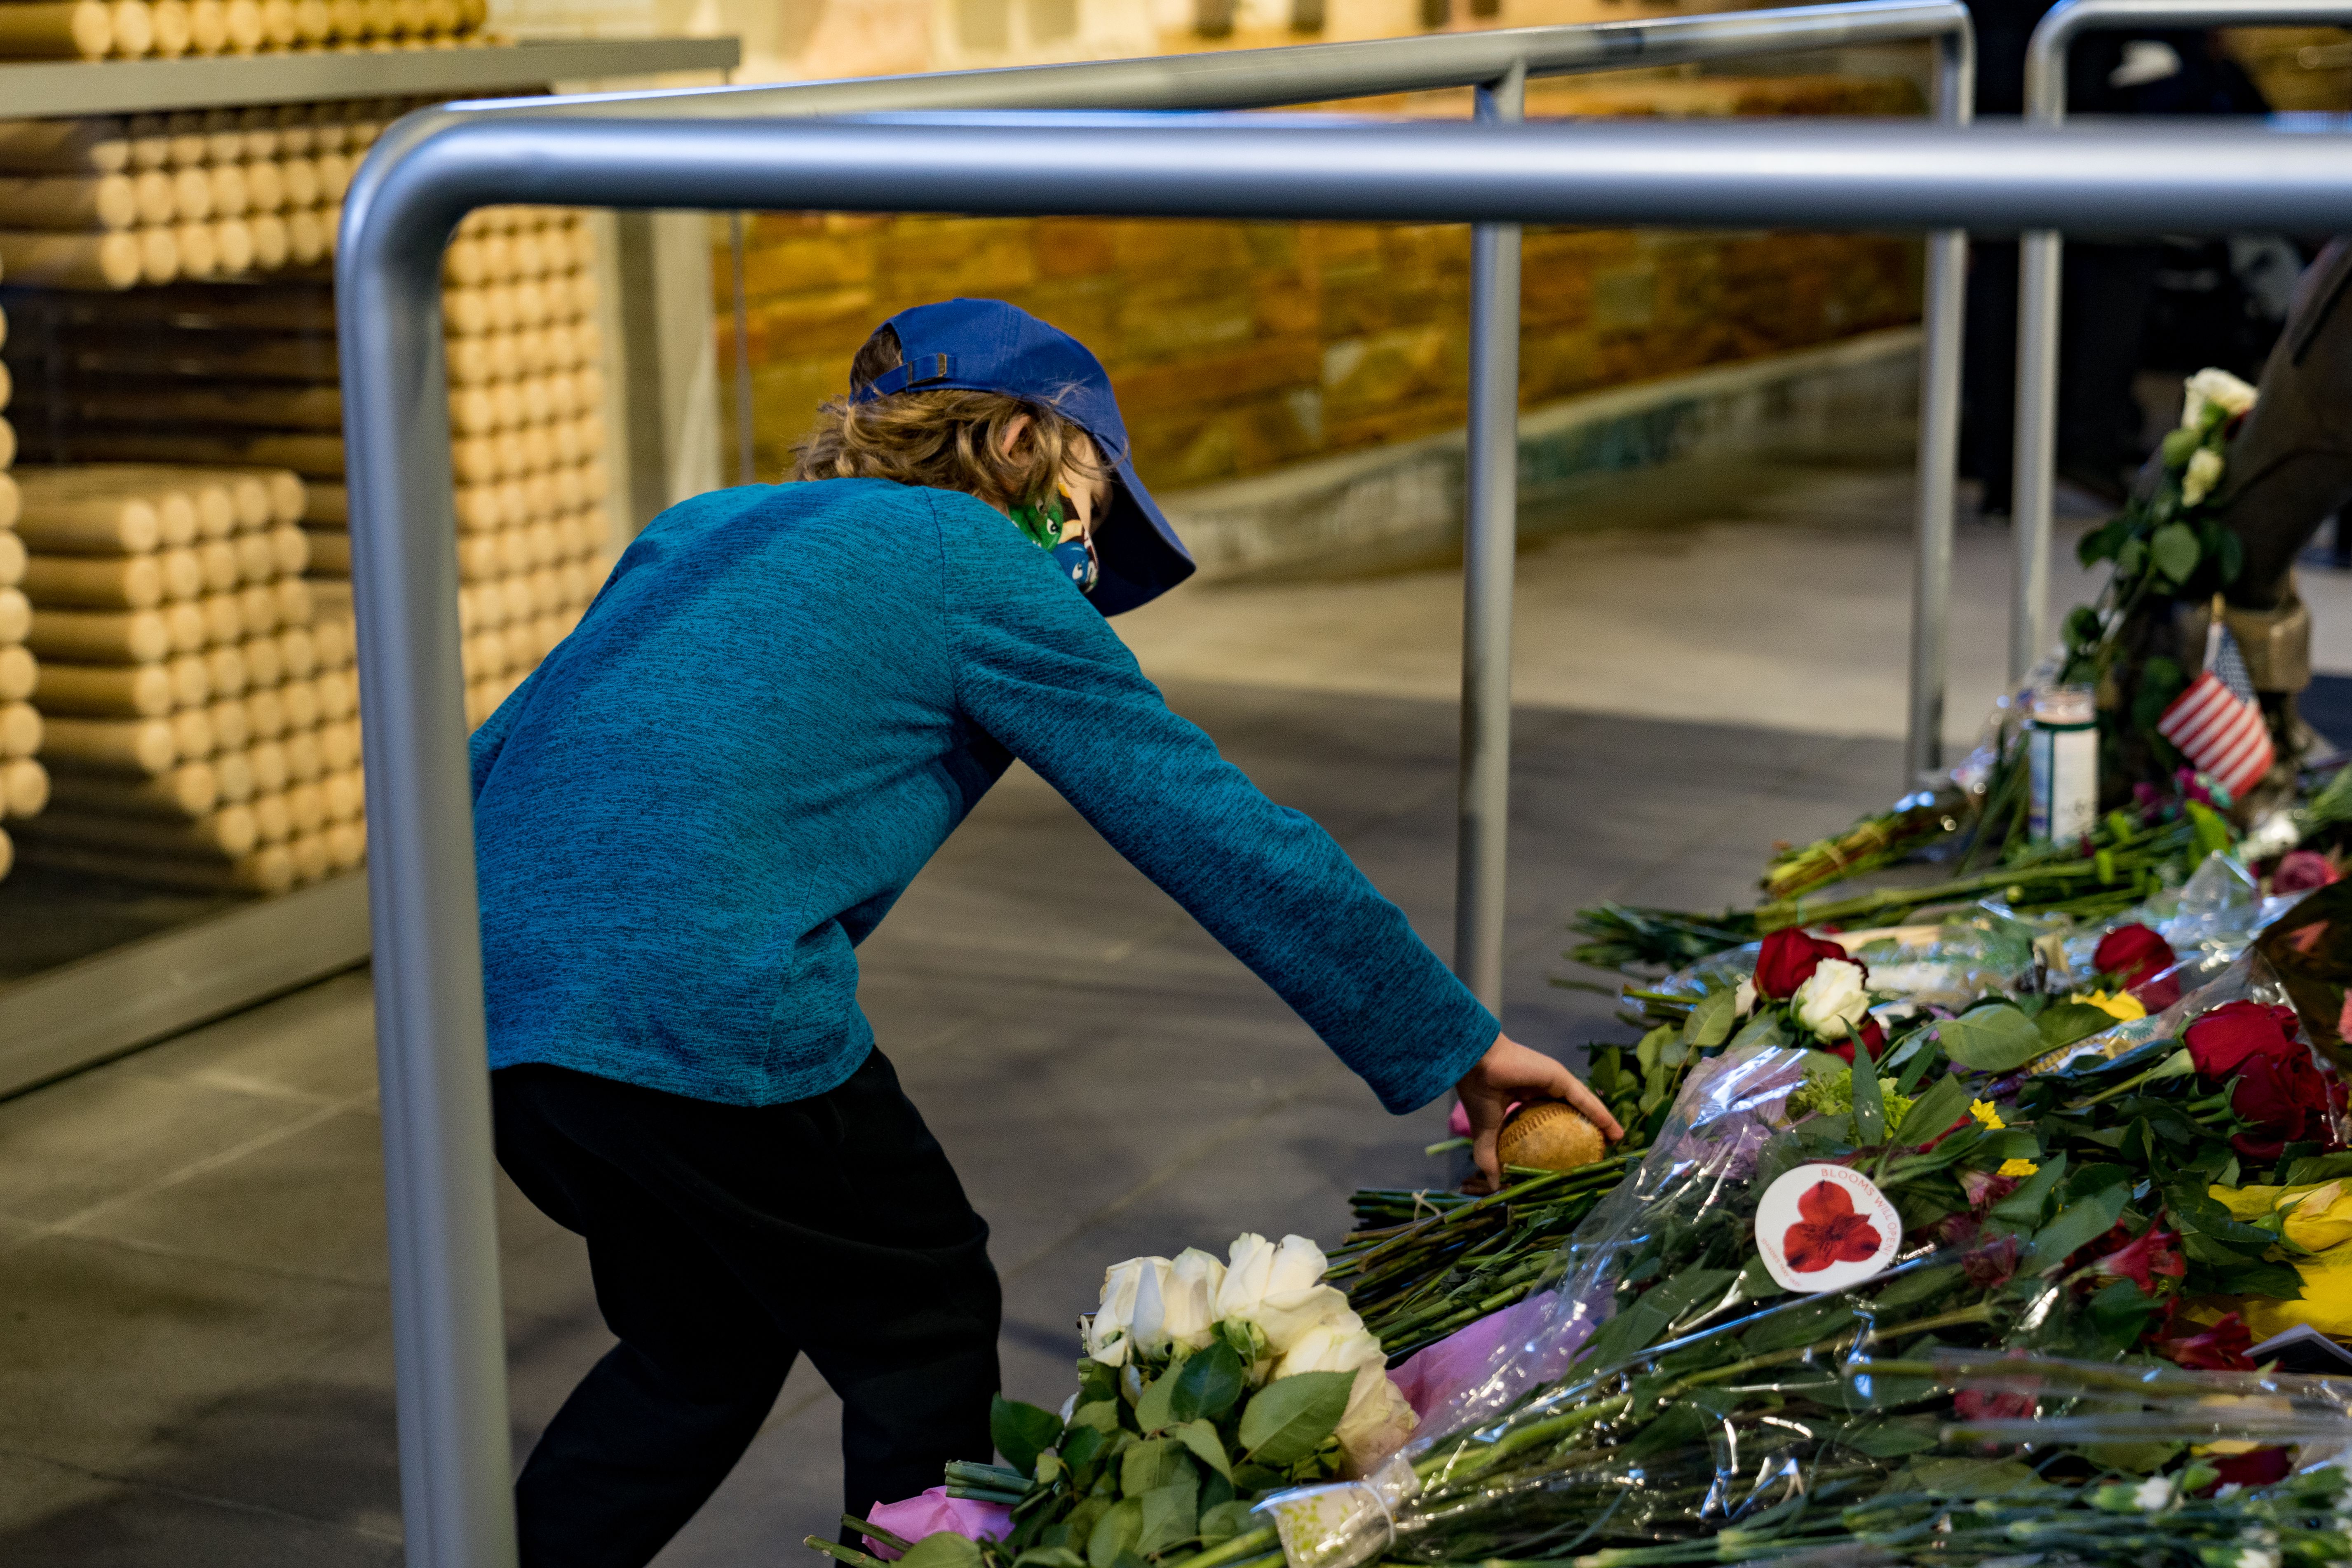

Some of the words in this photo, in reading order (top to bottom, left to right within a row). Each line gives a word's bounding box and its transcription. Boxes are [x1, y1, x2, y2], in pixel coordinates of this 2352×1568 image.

[1821, 1168, 1874, 1196] BLOOMS
[1874, 1196, 1894, 1221] WILL
[1779, 1263, 1790, 1277] MAY
[1789, 1277, 1801, 1286] VARY
